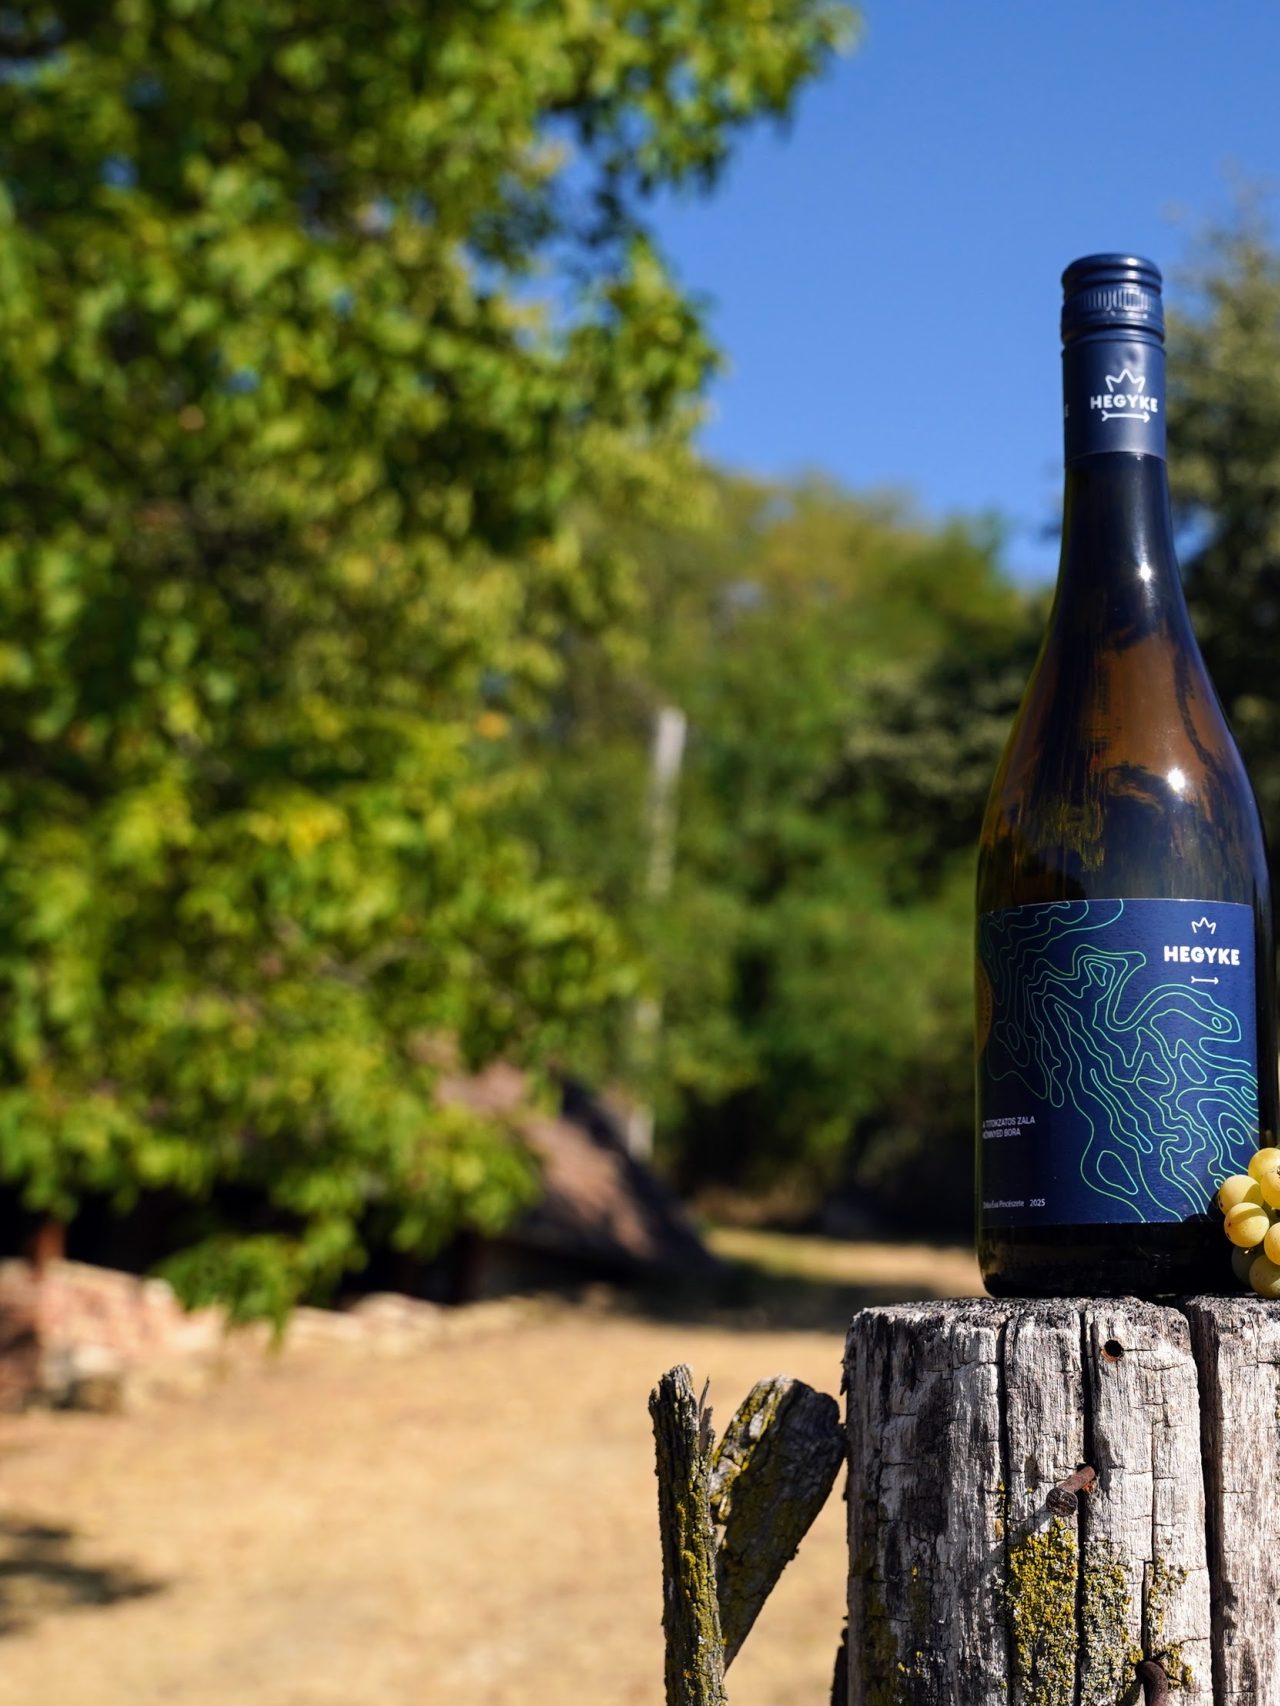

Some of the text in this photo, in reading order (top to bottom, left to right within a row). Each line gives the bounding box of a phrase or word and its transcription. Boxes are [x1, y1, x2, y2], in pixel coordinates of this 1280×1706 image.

[1090, 393, 1158, 413] HEGYKE
[1163, 945, 1240, 966] HEGYKE
[1017, 1116, 1036, 1125] ZALA
[1004, 1128, 1021, 1137] BORA
[1030, 1198, 1046, 1207] 2025
